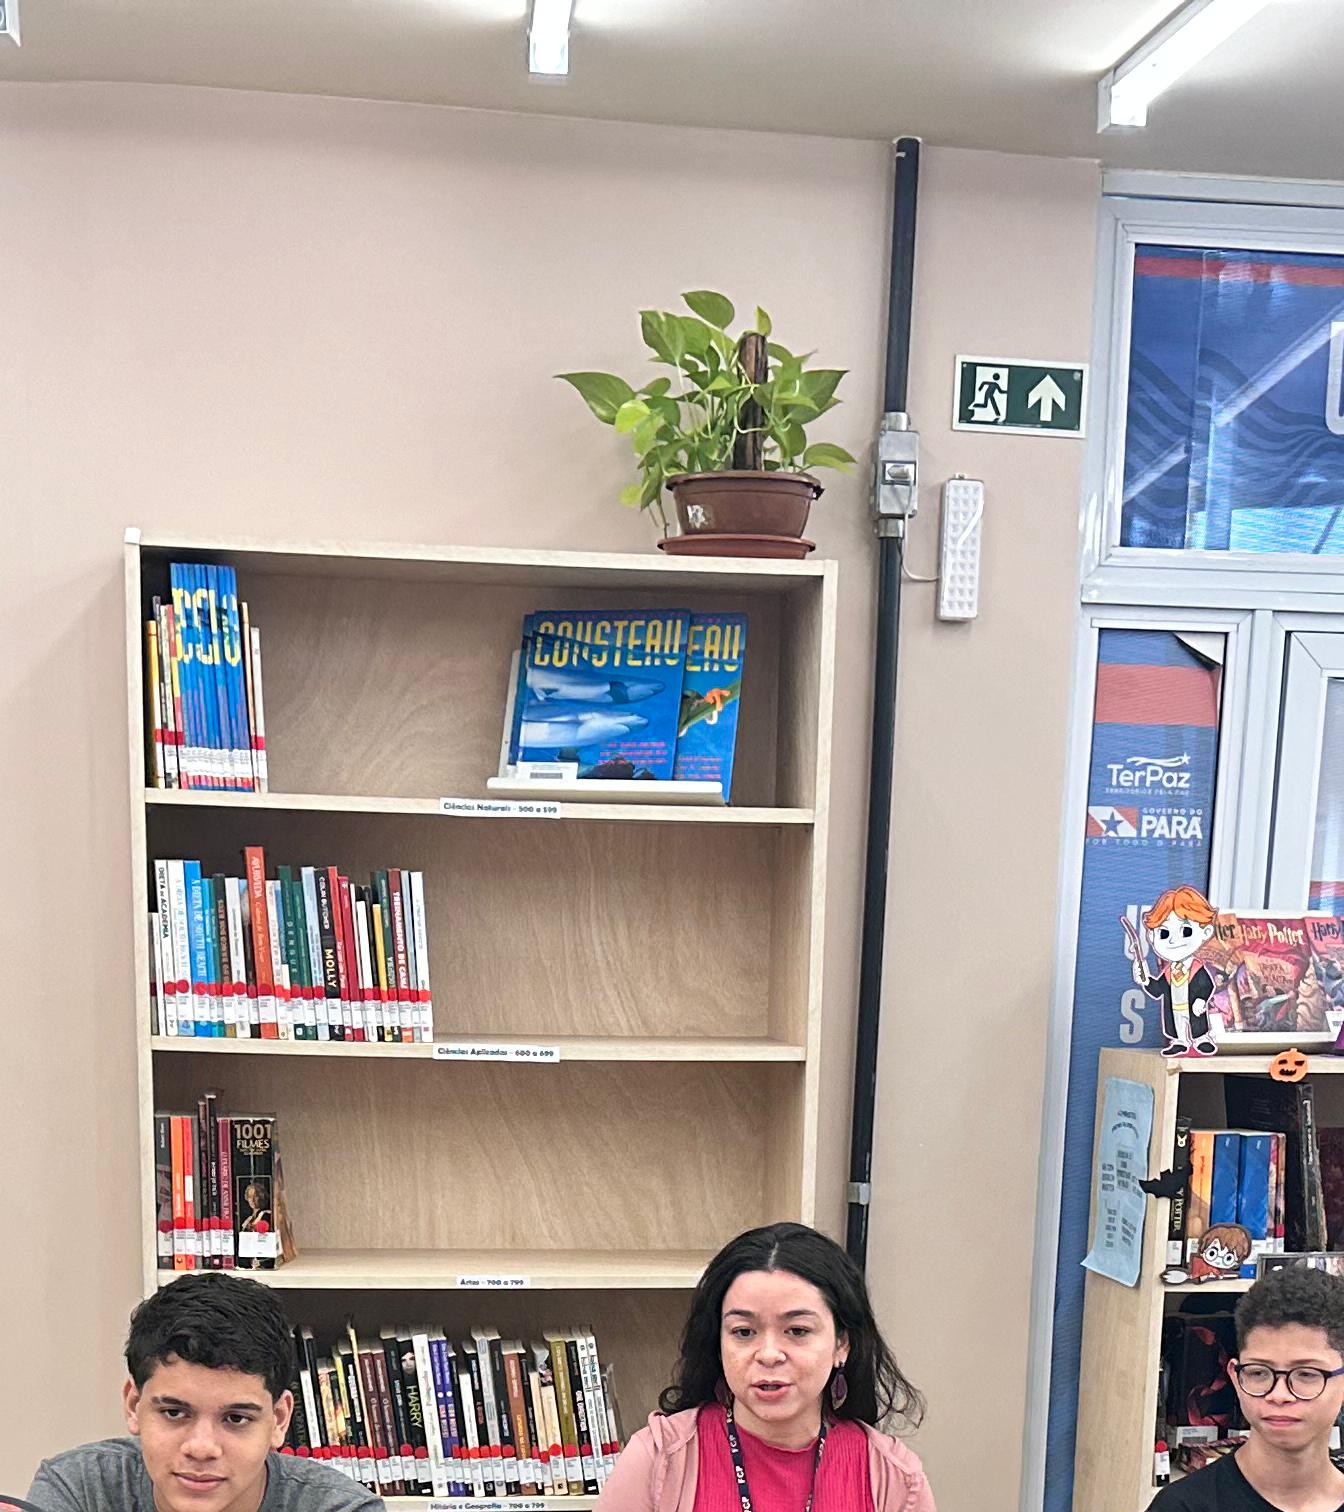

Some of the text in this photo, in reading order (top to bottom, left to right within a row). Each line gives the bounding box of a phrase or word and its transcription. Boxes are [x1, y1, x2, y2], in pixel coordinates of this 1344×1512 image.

[534, 620, 682, 667] COUSTEAU
[1107, 764, 1192, 788] TerPaz
[1142, 807, 1186, 815] GOVERNO
[1140, 815, 1203, 839] PARÁ
[160, 898, 169, 939] ACADEMIA
[1238, 922, 1306, 947] Harry Potter
[1311, 921, 1340, 941] Harry
[324, 948, 337, 988] MOLLY
[234, 1123, 272, 1140] 1001
[236, 1139, 270, 1150] FILMES
[406, 1385, 423, 1428] HARRY
[464, 1502, 502, 1510] Geografia
